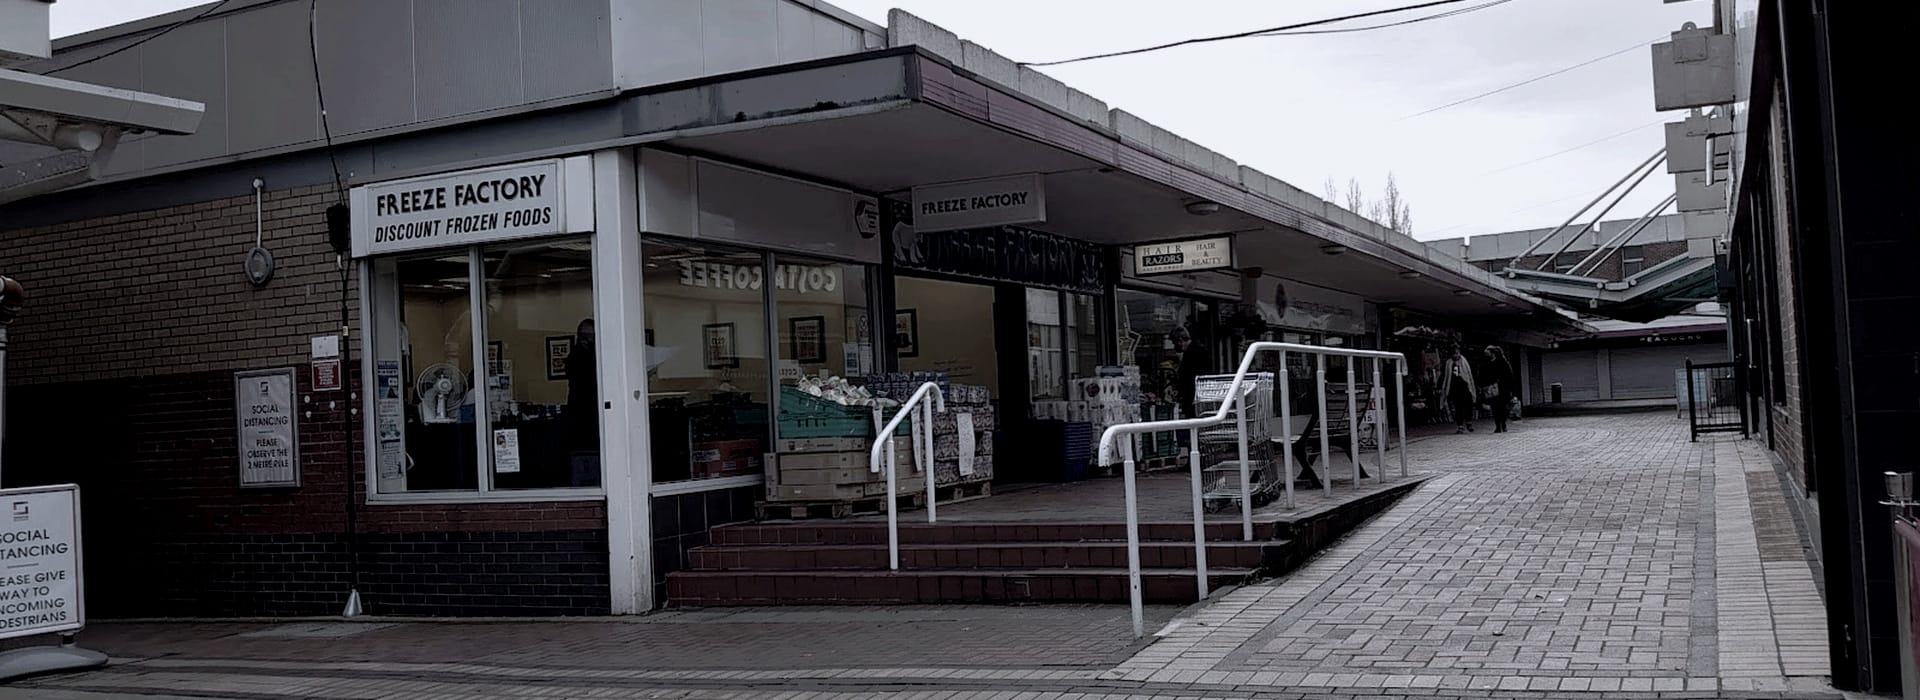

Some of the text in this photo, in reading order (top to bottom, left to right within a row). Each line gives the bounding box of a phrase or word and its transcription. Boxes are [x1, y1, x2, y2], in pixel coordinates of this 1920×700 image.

[377, 174, 545, 216] FREEZE FACTORY
[921, 191, 1028, 215] FREEZE FACTORY
[375, 207, 551, 243] DISCOUNT FROZEN FOODS
[1143, 245, 1182, 256] HAIR
[1196, 242, 1216, 252] HAIR
[1144, 255, 1183, 267] RAZORS
[1192, 256, 1222, 266] BEAUTY
[252, 404, 279, 414] SOCIAL
[244, 416, 288, 427] DISTANCING
[256, 438, 278, 447] PLEASE
[247, 448, 288, 459] OBSERVE THE
[34, 570, 65, 583] GIVE
[0, 586, 50, 601] WAY TO
